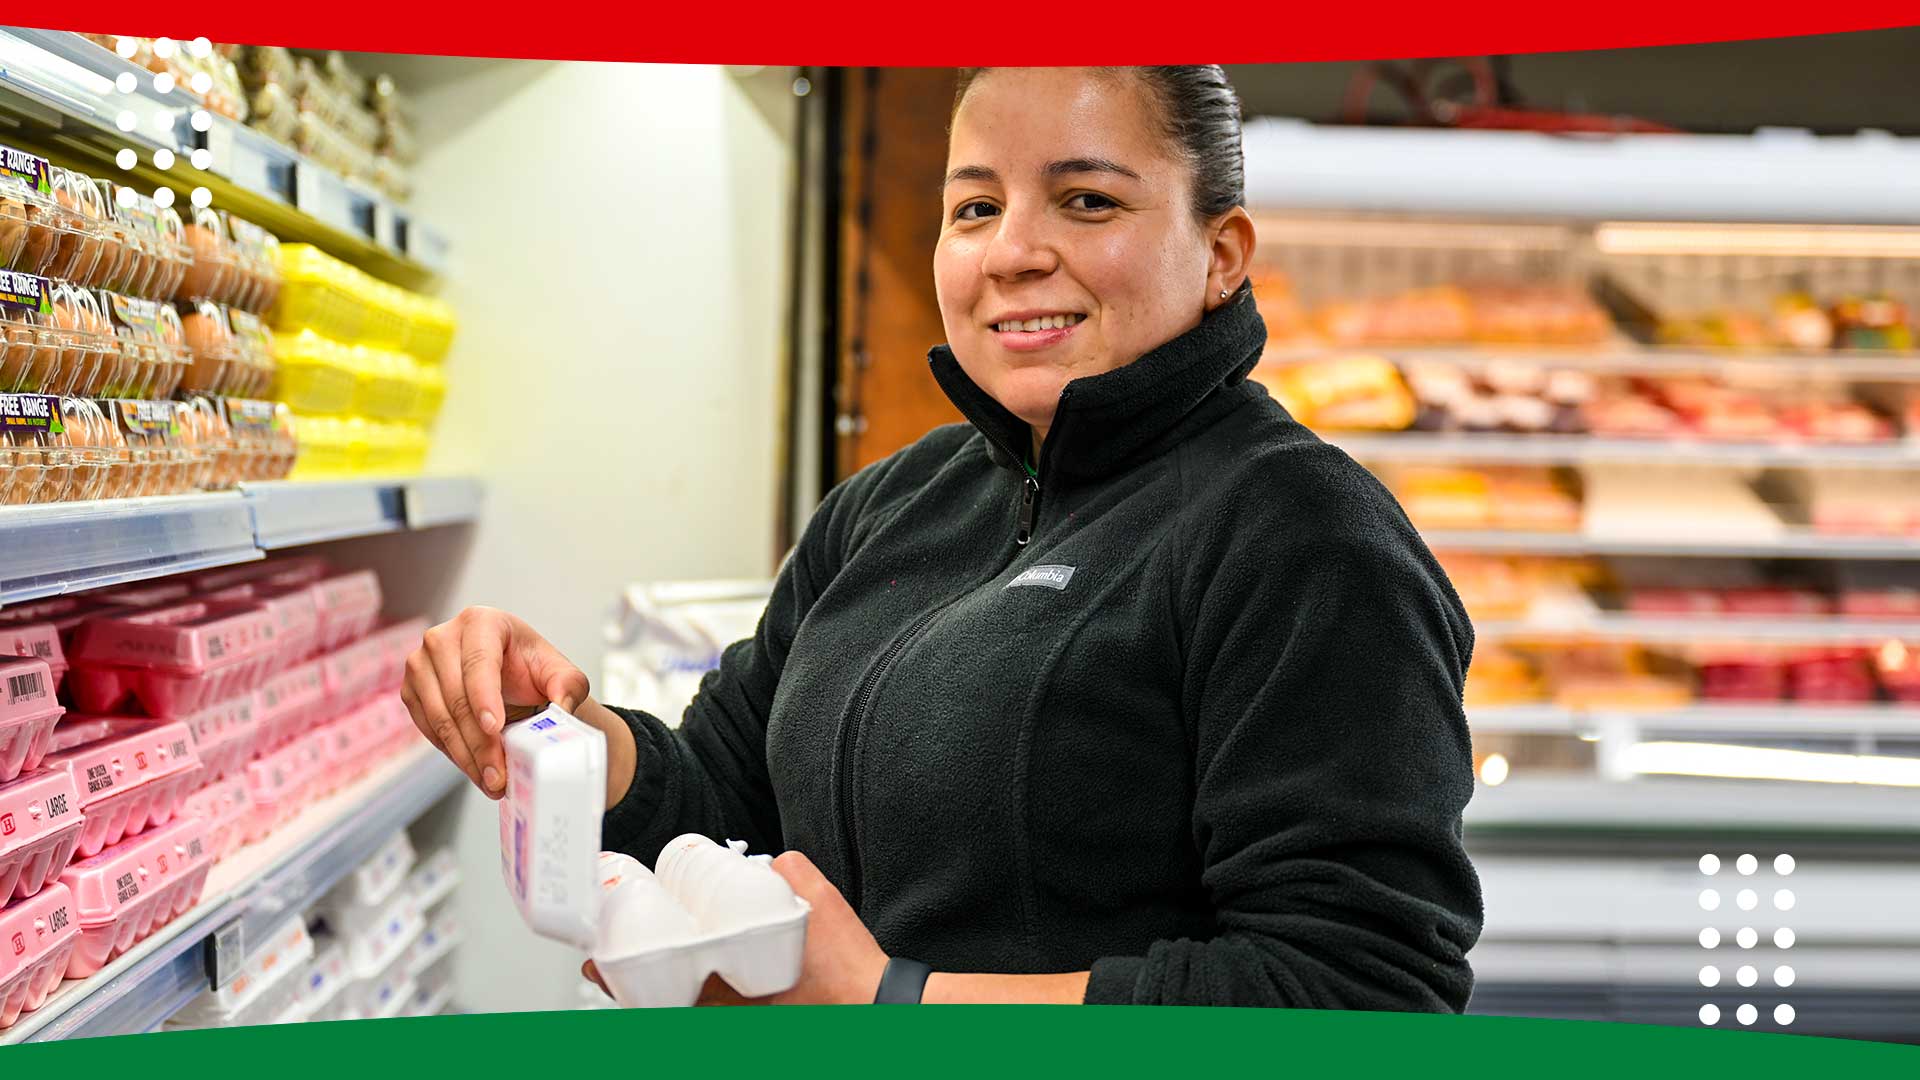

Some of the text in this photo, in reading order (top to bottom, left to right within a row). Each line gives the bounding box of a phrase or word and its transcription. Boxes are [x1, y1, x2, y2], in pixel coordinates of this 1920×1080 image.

[7, 149, 38, 176] RANGE
[12, 272, 40, 297] RANGE
[0, 396, 50, 417] FREE RANGE
[45, 793, 69, 819] LARGE
[48, 906, 69, 933] LARGE
